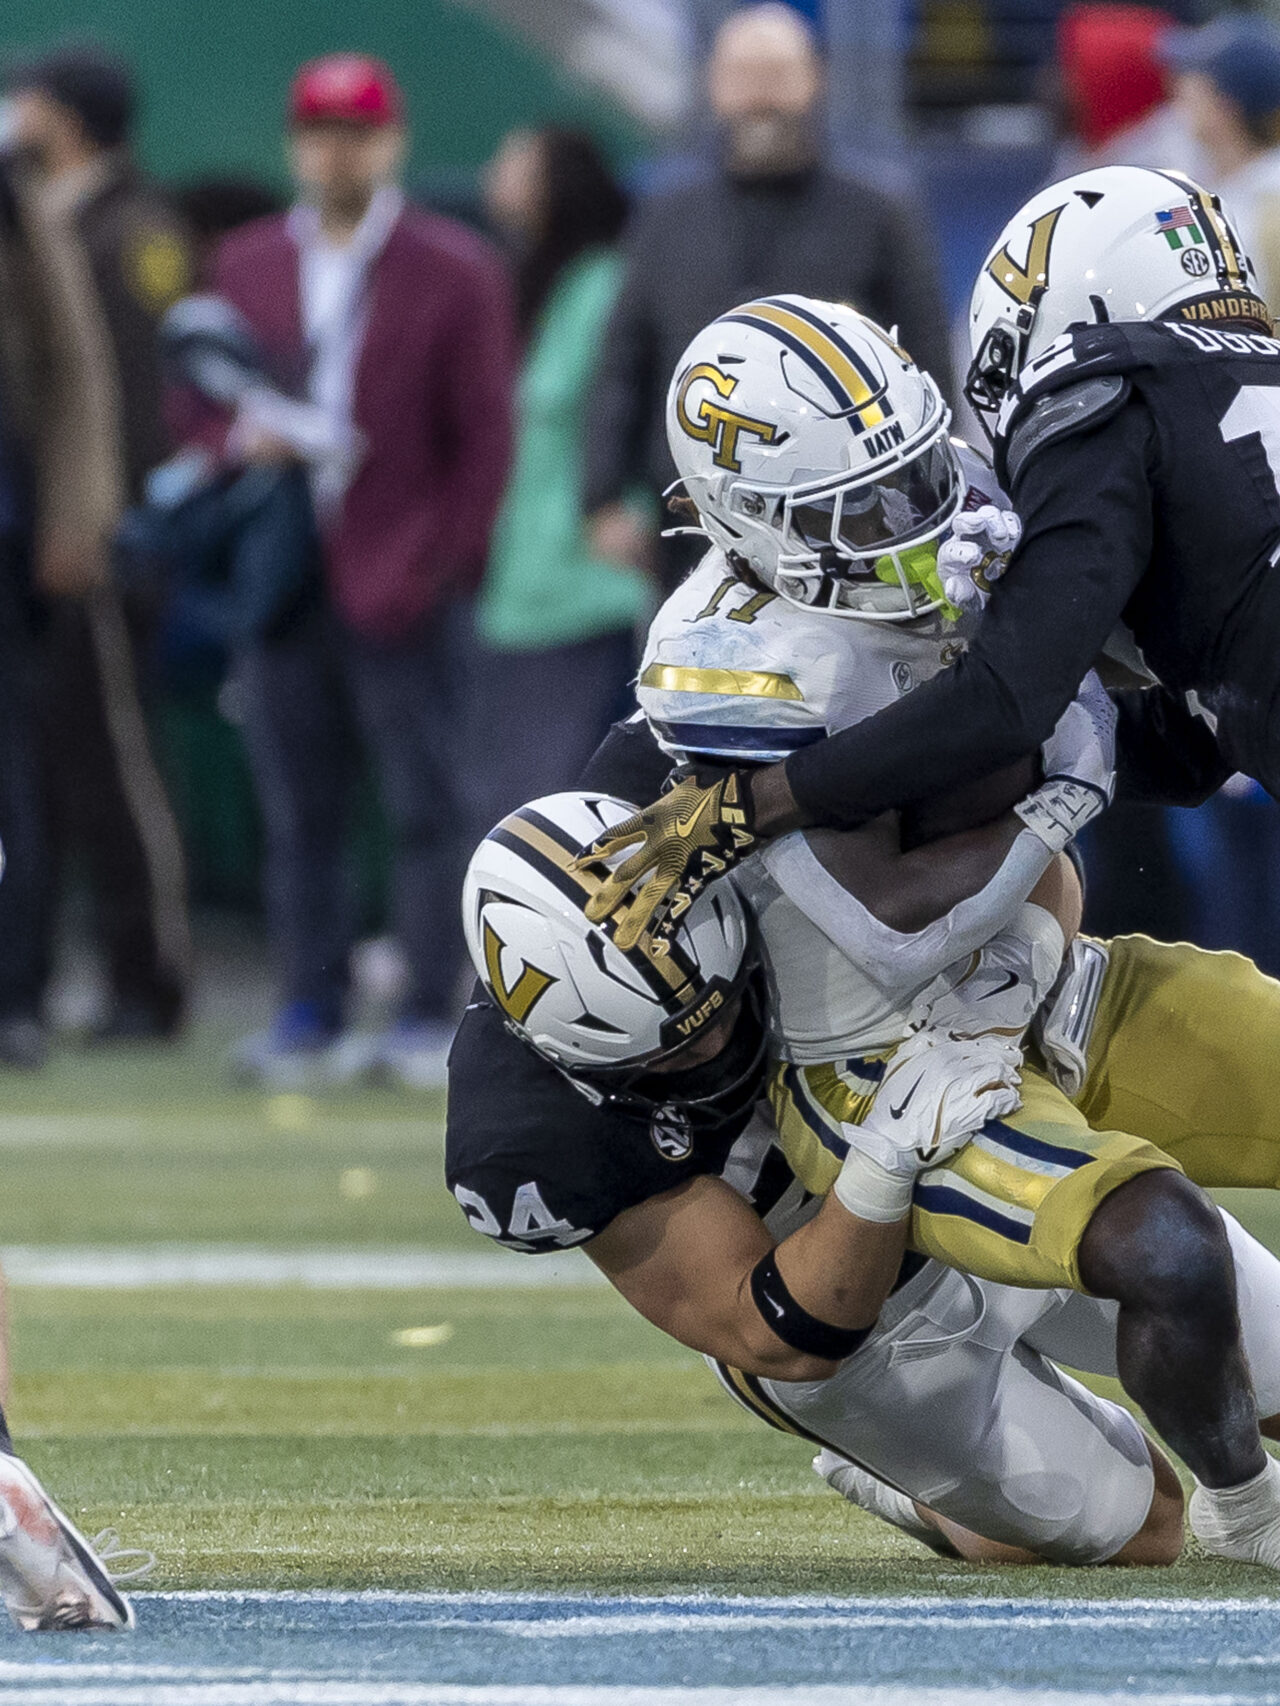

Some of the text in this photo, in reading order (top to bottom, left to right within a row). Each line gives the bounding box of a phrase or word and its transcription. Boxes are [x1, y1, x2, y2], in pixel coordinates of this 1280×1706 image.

[984, 202, 1069, 306] V
[1183, 250, 1208, 276] SEC
[676, 361, 778, 475] GT
[483, 914, 561, 1027] V
